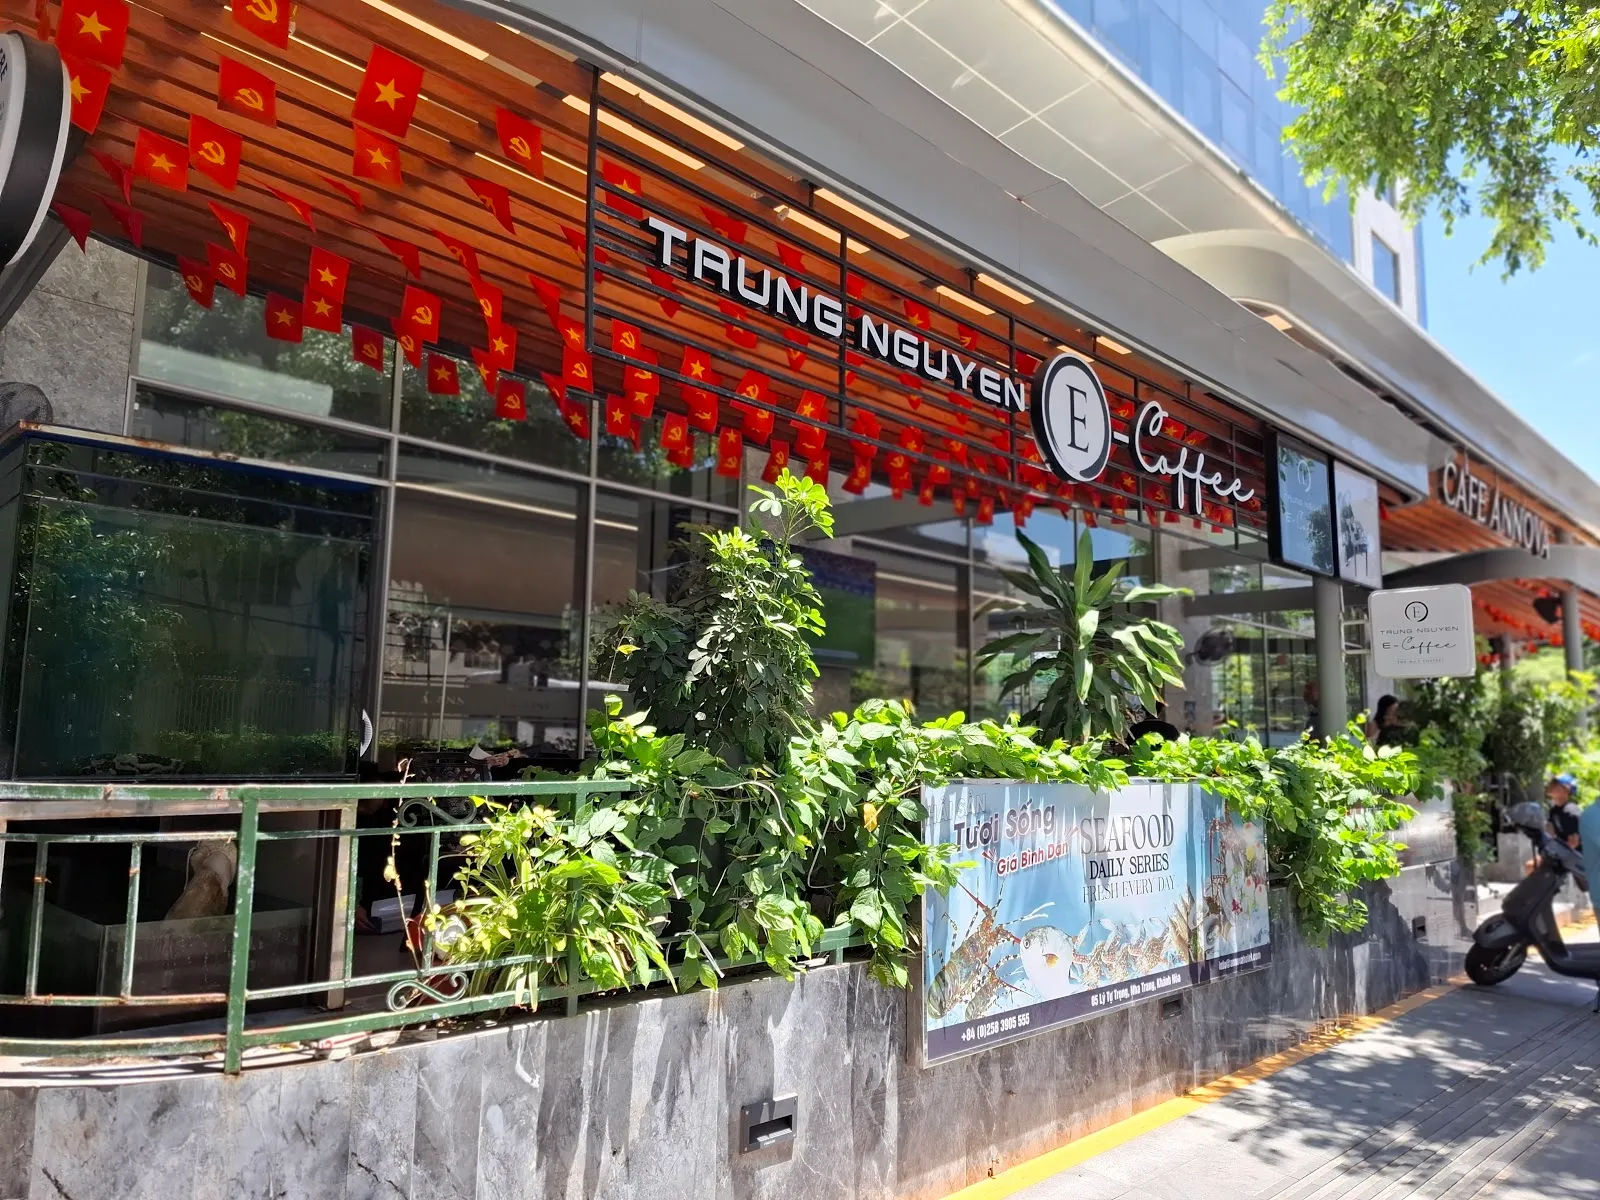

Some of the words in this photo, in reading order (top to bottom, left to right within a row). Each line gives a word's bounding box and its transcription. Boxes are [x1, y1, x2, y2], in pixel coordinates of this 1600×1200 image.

[646, 216, 844, 338] TRUNG
[861, 314, 1026, 412] NGUYEN
[1443, 462, 1489, 522] CAFE
[1488, 486, 1550, 560] ANNOVA
[1380, 628, 1413, 636] TRUNG
[1416, 625, 1459, 633] NGUYEN
[1382, 636, 1457, 654] E-Coffee
[953, 813, 1000, 852] Tươi
[1005, 797, 1055, 838] Sống
[1080, 814, 1174, 855] SEAFOOD
[997, 853, 1018, 875] Giá
[1089, 856, 1126, 880] DAILY
[1129, 852, 1170, 875] SERIES
[1082, 882, 1119, 903] FRESH
[1122, 876, 1157, 898] EVERY
[1158, 874, 1176, 892] DAY
[961, 1026, 976, 1042] +84
[976, 1020, 1000, 1040] (0)258
[1000, 1015, 1017, 1032] 3905
[1017, 1012, 1030, 1027] 555
